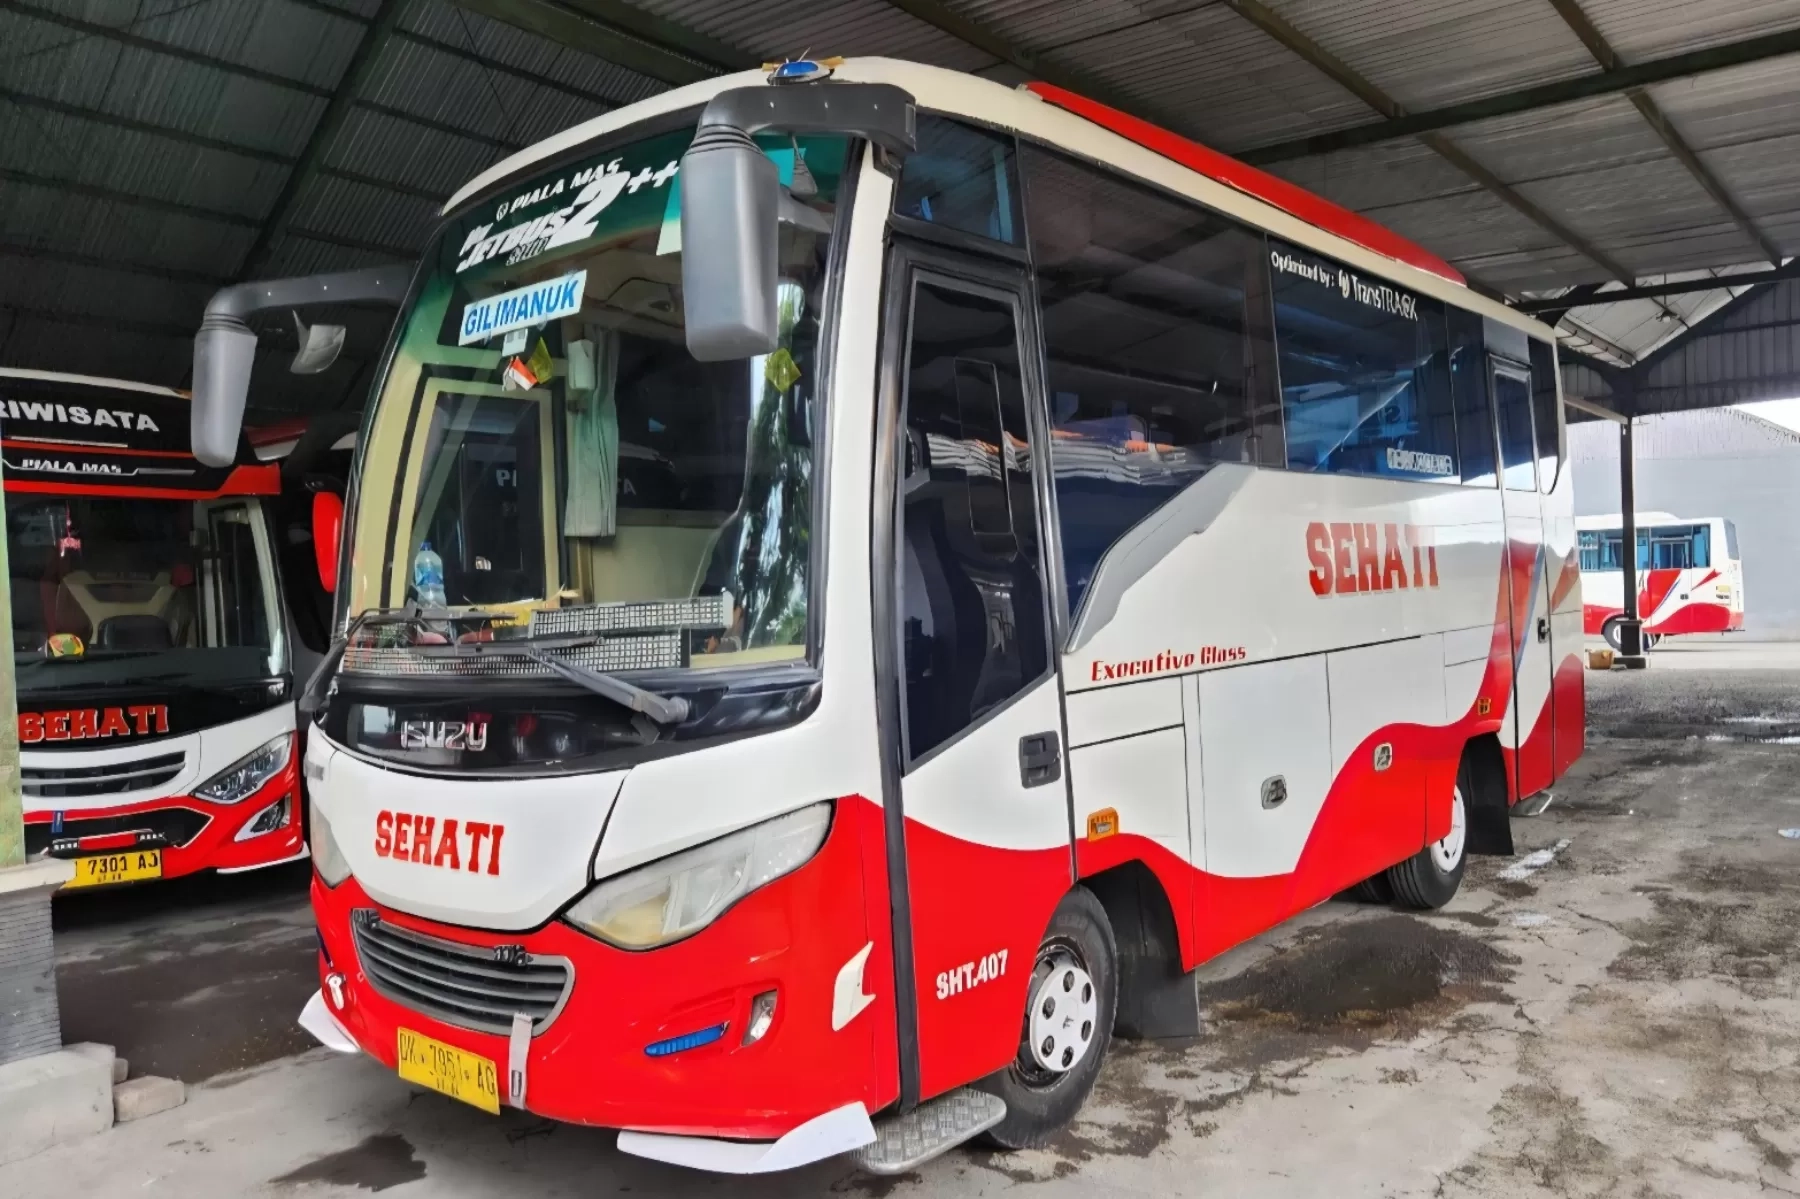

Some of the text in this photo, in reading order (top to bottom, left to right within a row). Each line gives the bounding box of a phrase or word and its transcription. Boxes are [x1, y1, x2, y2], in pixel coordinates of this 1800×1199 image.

[510, 179, 565, 213] PIALA
[465, 280, 579, 336] GILIMANUK
[1305, 522, 1439, 598] SEHATI
[1091, 649, 1195, 681] Executive
[18, 704, 169, 743] SEHATI
[401, 720, 487, 751] ISUZU
[375, 809, 504, 876] SEHATI
[936, 949, 1009, 1000] SHT.407
